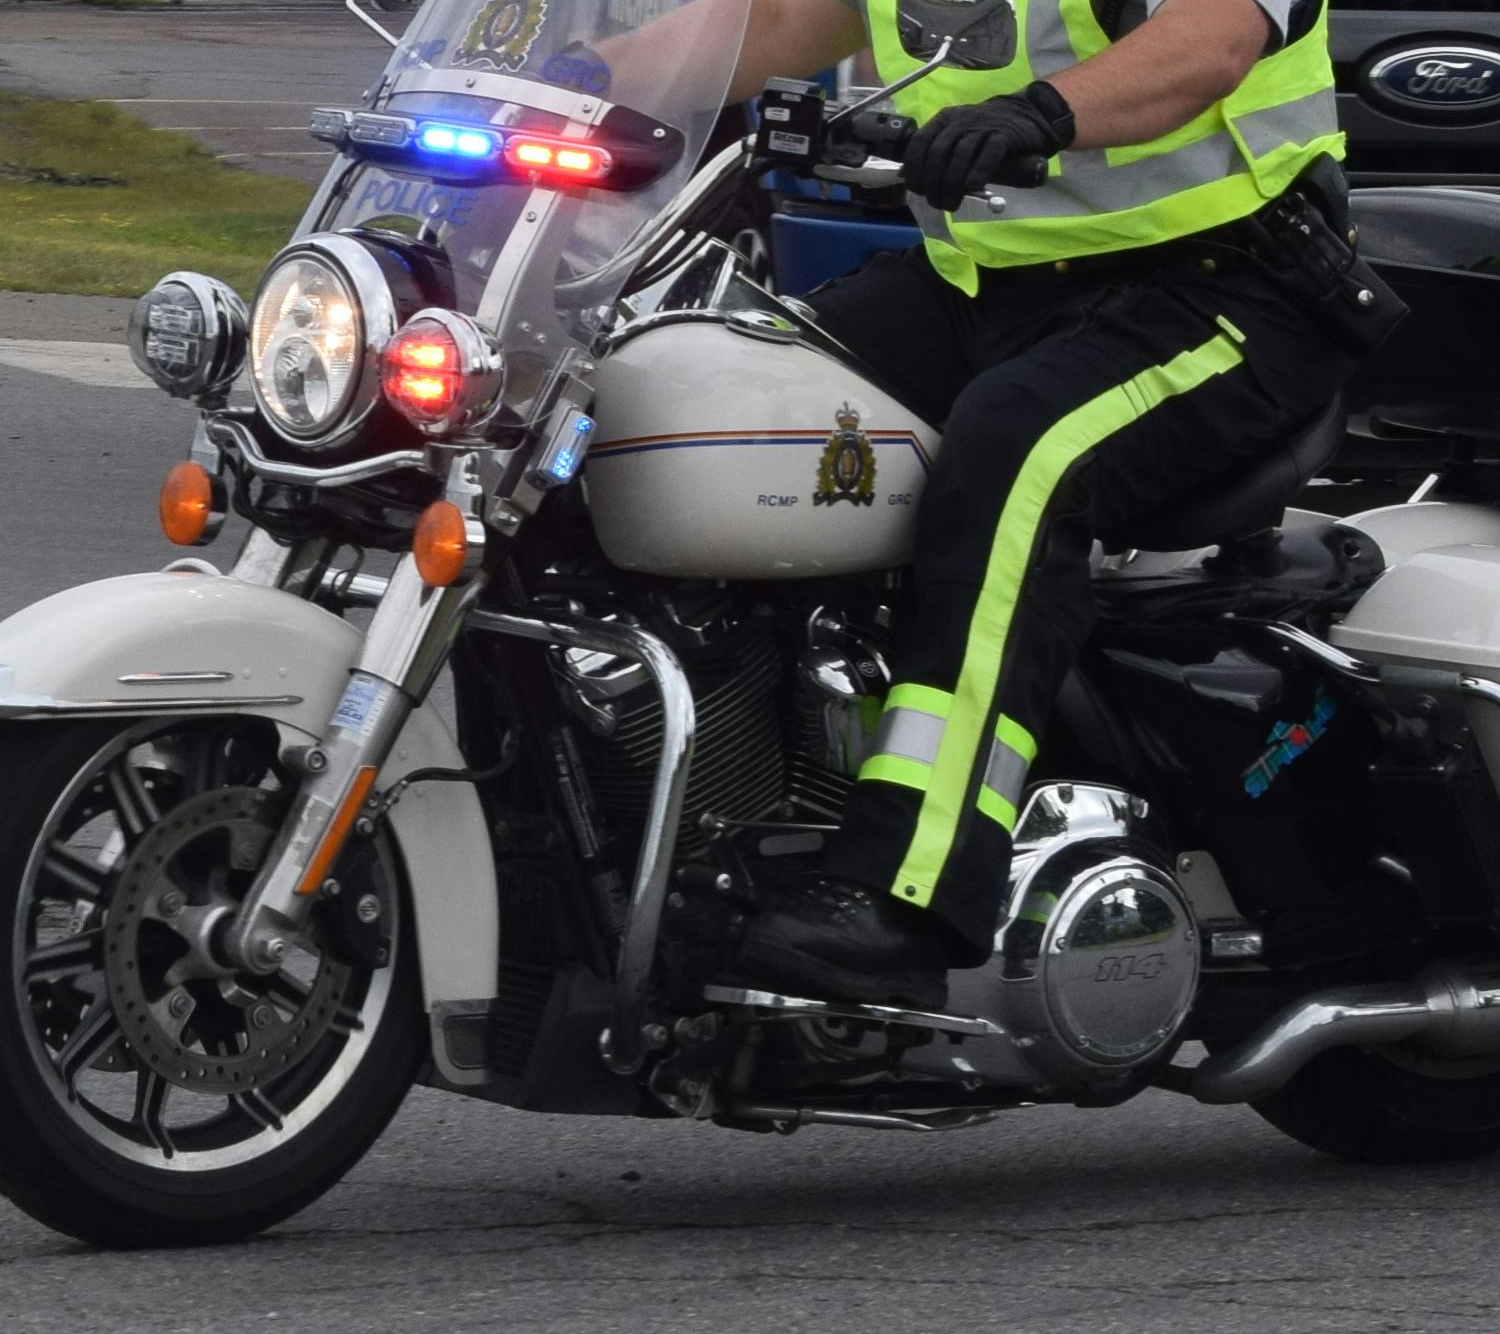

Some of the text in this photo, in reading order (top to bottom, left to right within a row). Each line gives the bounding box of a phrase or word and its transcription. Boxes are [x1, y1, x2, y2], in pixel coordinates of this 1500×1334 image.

[541, 51, 612, 93] GRC
[1406, 59, 1494, 95] Ford
[356, 179, 480, 226] POLICE
[757, 493, 913, 507] RCMP GRC
[1094, 952, 1169, 983] 114
